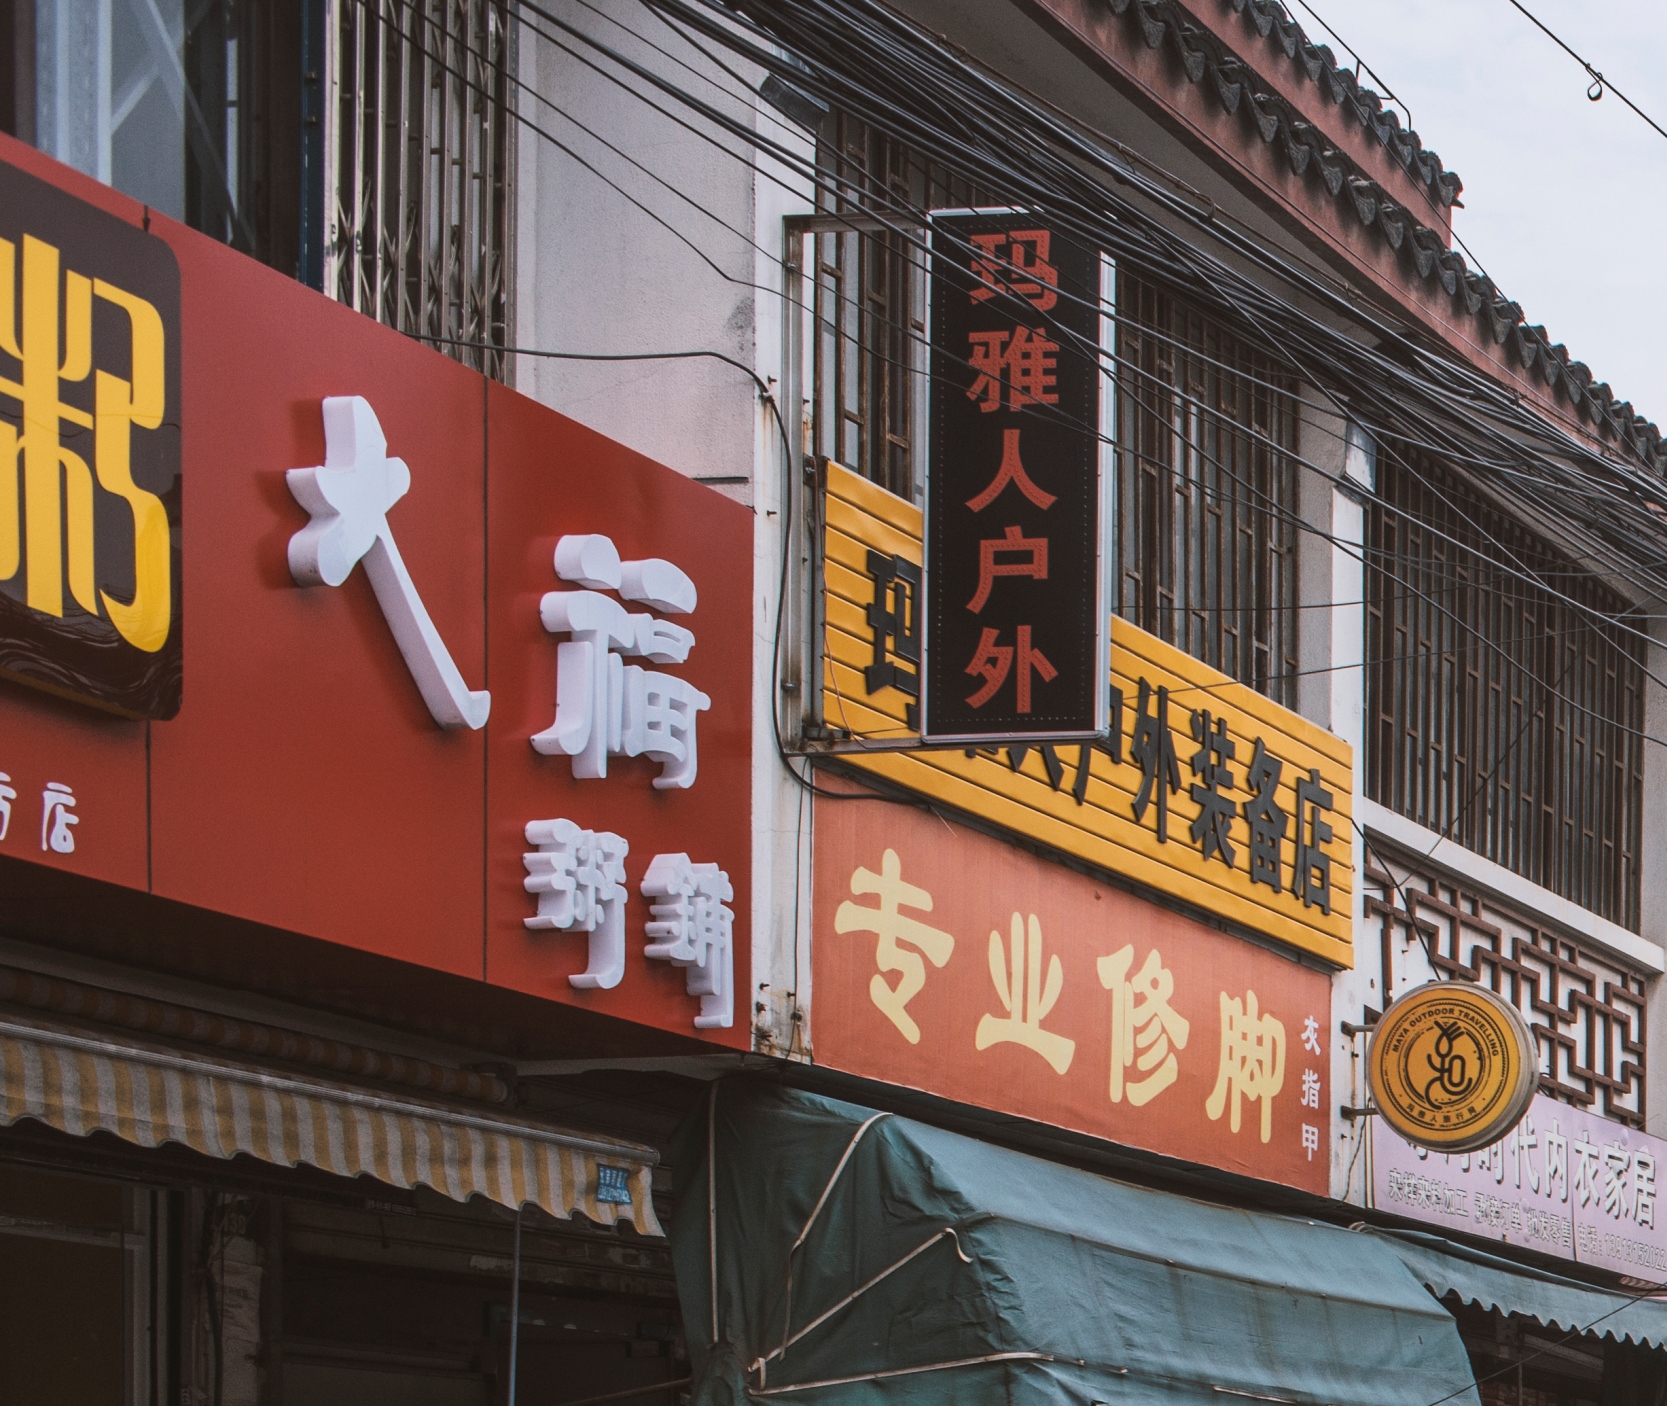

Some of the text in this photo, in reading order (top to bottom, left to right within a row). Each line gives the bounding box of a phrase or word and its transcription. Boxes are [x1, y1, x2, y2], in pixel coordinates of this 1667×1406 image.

[965, 229, 1059, 714] 玛雅人户外
[834, 847, 1287, 1144] 专业修脚
[1393, 1008, 1499, 1057] MAYA OUTDOOR TRAVELLING
[1300, 1014, 1321, 1162] 灰指甲
[1526, 1205, 1572, 1249] 批发零售
